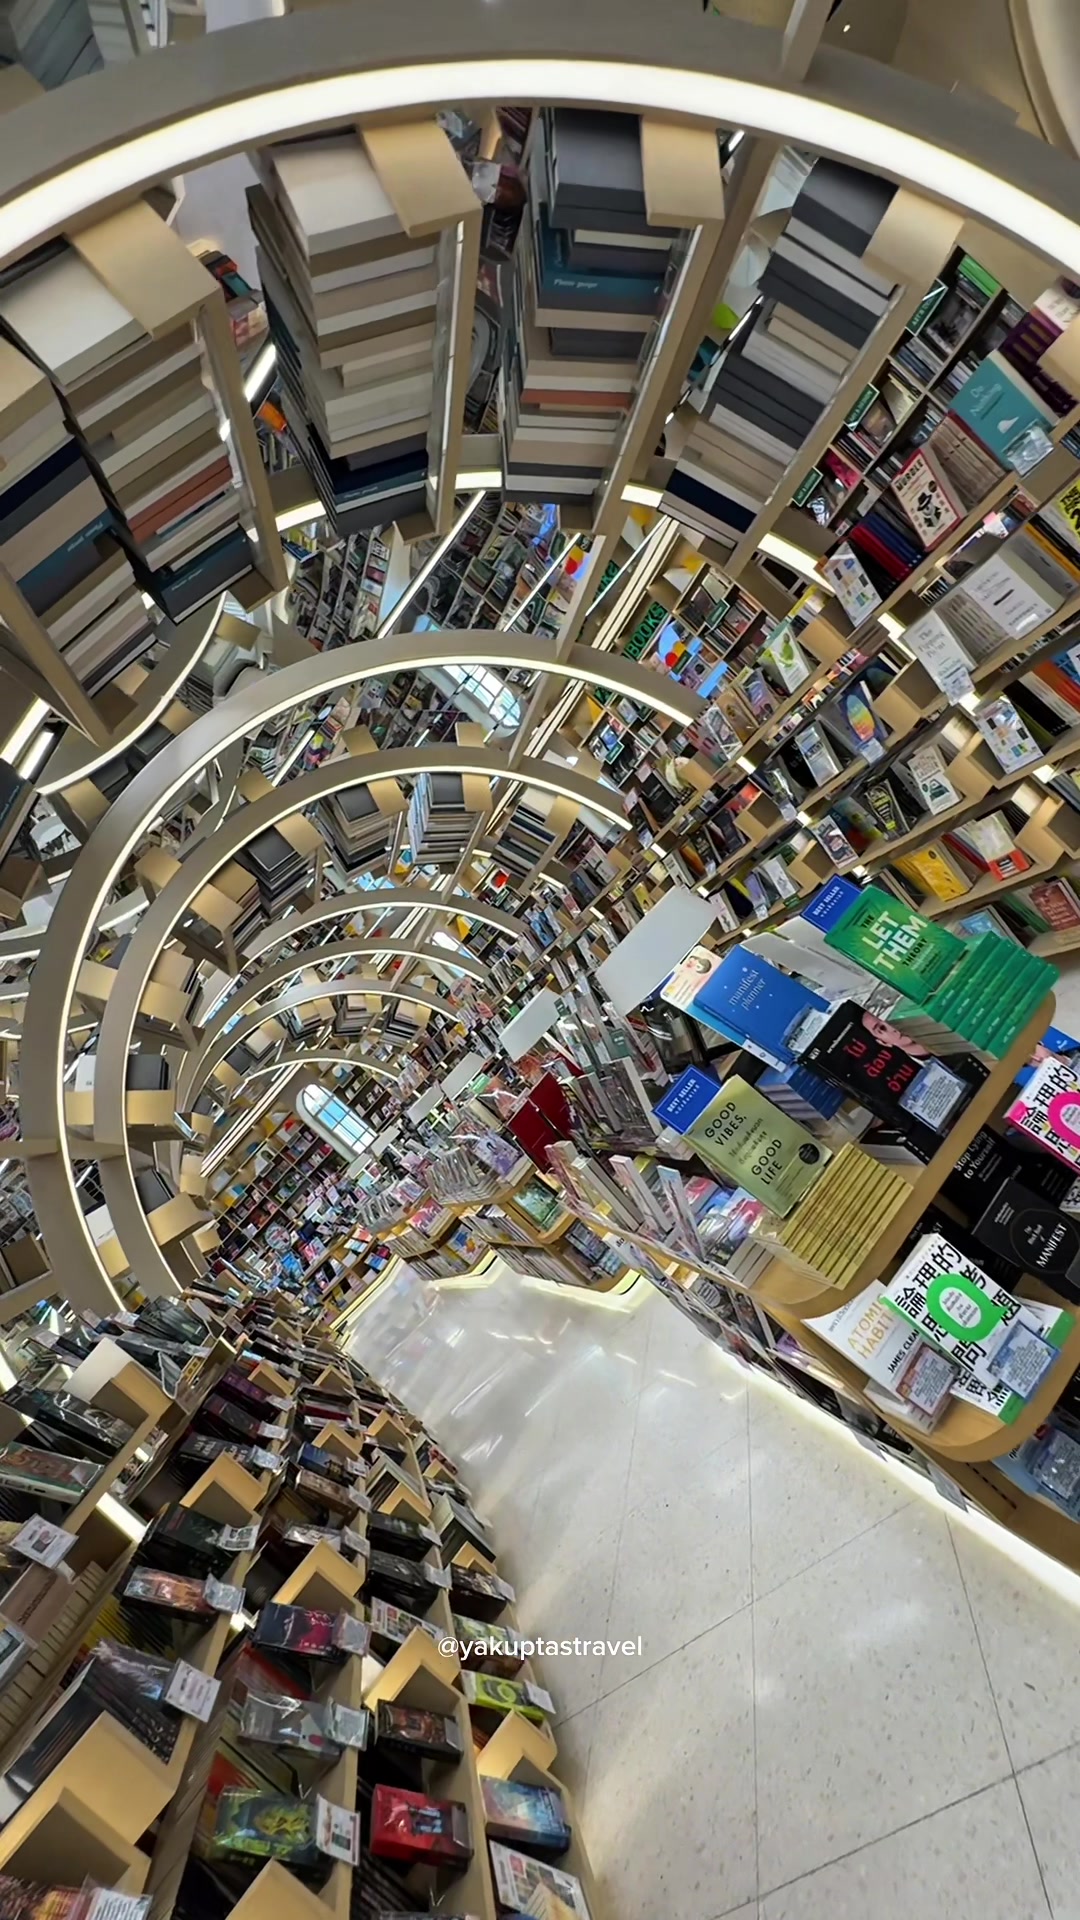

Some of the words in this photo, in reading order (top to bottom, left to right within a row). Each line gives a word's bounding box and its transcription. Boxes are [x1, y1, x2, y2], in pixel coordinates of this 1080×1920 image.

[624, 602, 668, 660] BOOKS
[812, 901, 827, 917] BEST
[824, 886, 841, 906] SELLER
[861, 914, 875, 929] THE
[862, 911, 900, 950] LET
[873, 915, 928, 970] THEM
[902, 938, 928, 967] THEORY
[728, 969, 760, 1006] manifest
[741, 978, 768, 1012] planner
[844, 1037, 868, 1058] ไม่
[864, 1050, 893, 1078] ต้อง
[667, 1095, 681, 1113] BEST
[678, 1078, 697, 1099] SELLER
[886, 1064, 914, 1092] อ่าน
[1022, 1064, 1078, 1135] 論理的
[704, 1102, 736, 1138] GOOD
[714, 1115, 747, 1146] VIBES,
[751, 1139, 782, 1176] GOOD
[954, 1152, 971, 1172] Stop
[967, 1131, 988, 1153] Lying
[963, 1168, 975, 1180] to
[970, 1137, 996, 1170] Yourself
[760, 1160, 784, 1185] LIFE
[1036, 1222, 1067, 1268] MANIFEST
[894, 1242, 962, 1319] 論理的
[857, 1309, 895, 1360] HABIT
[888, 1350, 906, 1374] JAMES
